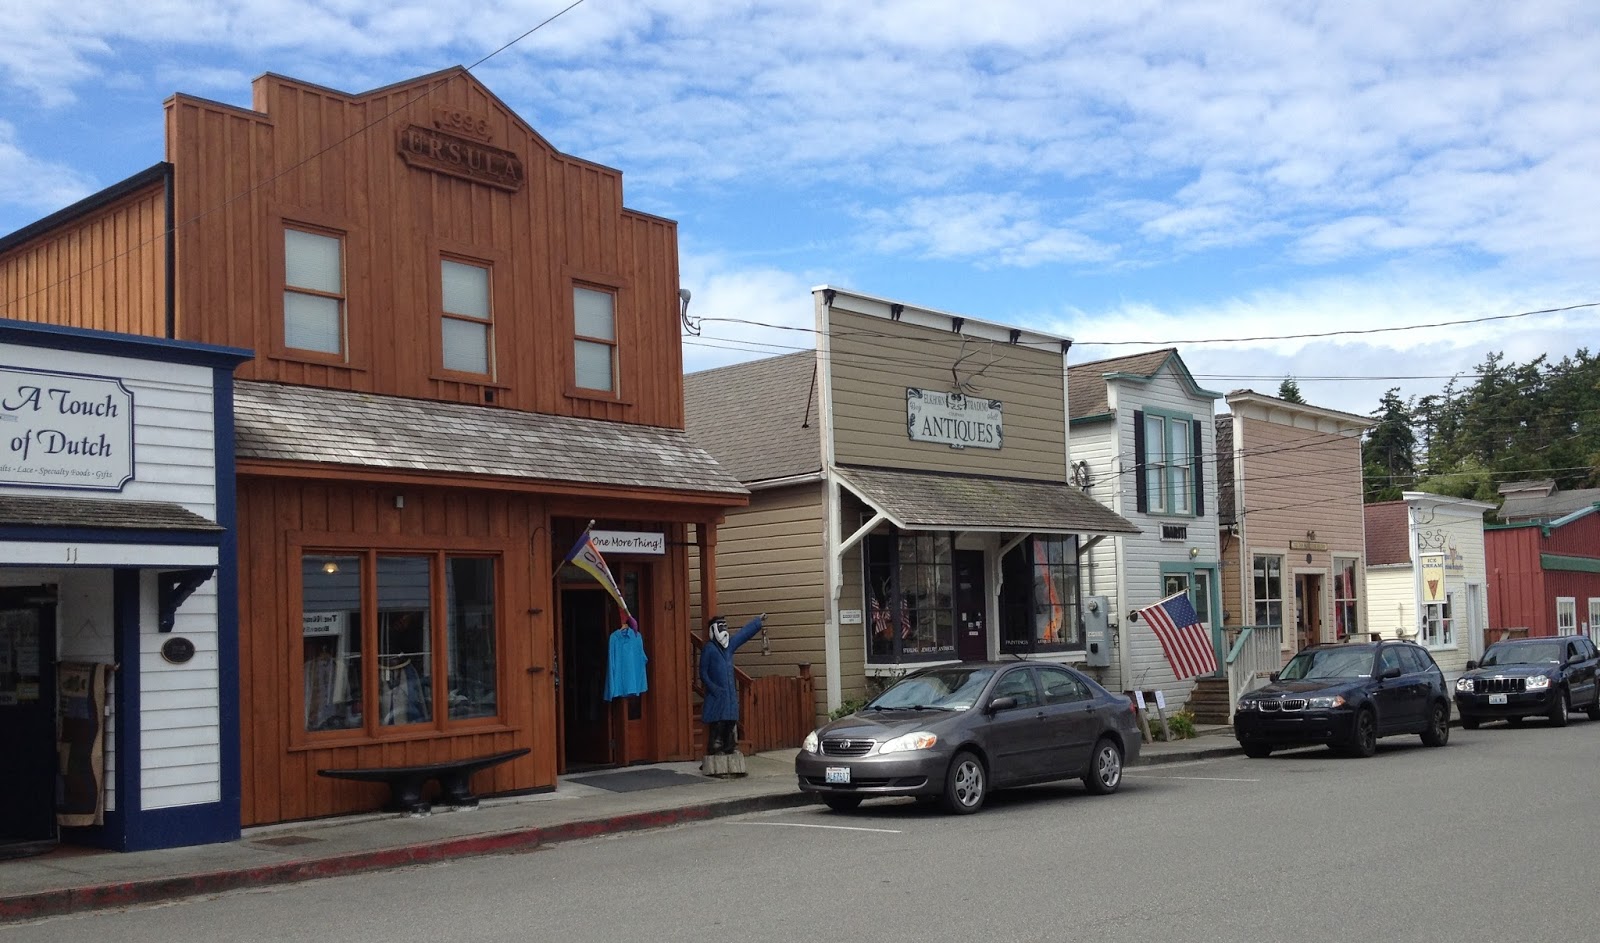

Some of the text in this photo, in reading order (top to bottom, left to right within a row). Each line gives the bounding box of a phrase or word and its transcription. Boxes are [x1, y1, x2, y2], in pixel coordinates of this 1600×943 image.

[408, 130, 517, 181] URSULA
[2, 386, 119, 418] A Touch
[966, 400, 989, 412] TRADING
[922, 416, 993, 443] ANTIQUES
[11, 429, 112, 461] of Dutch
[16, 466, 33, 474] Lace
[39, 467, 70, 477] Specialty
[70, 468, 91, 477] Foods
[96, 470, 113, 479] Gifts
[592, 536, 662, 551] One More Thing!
